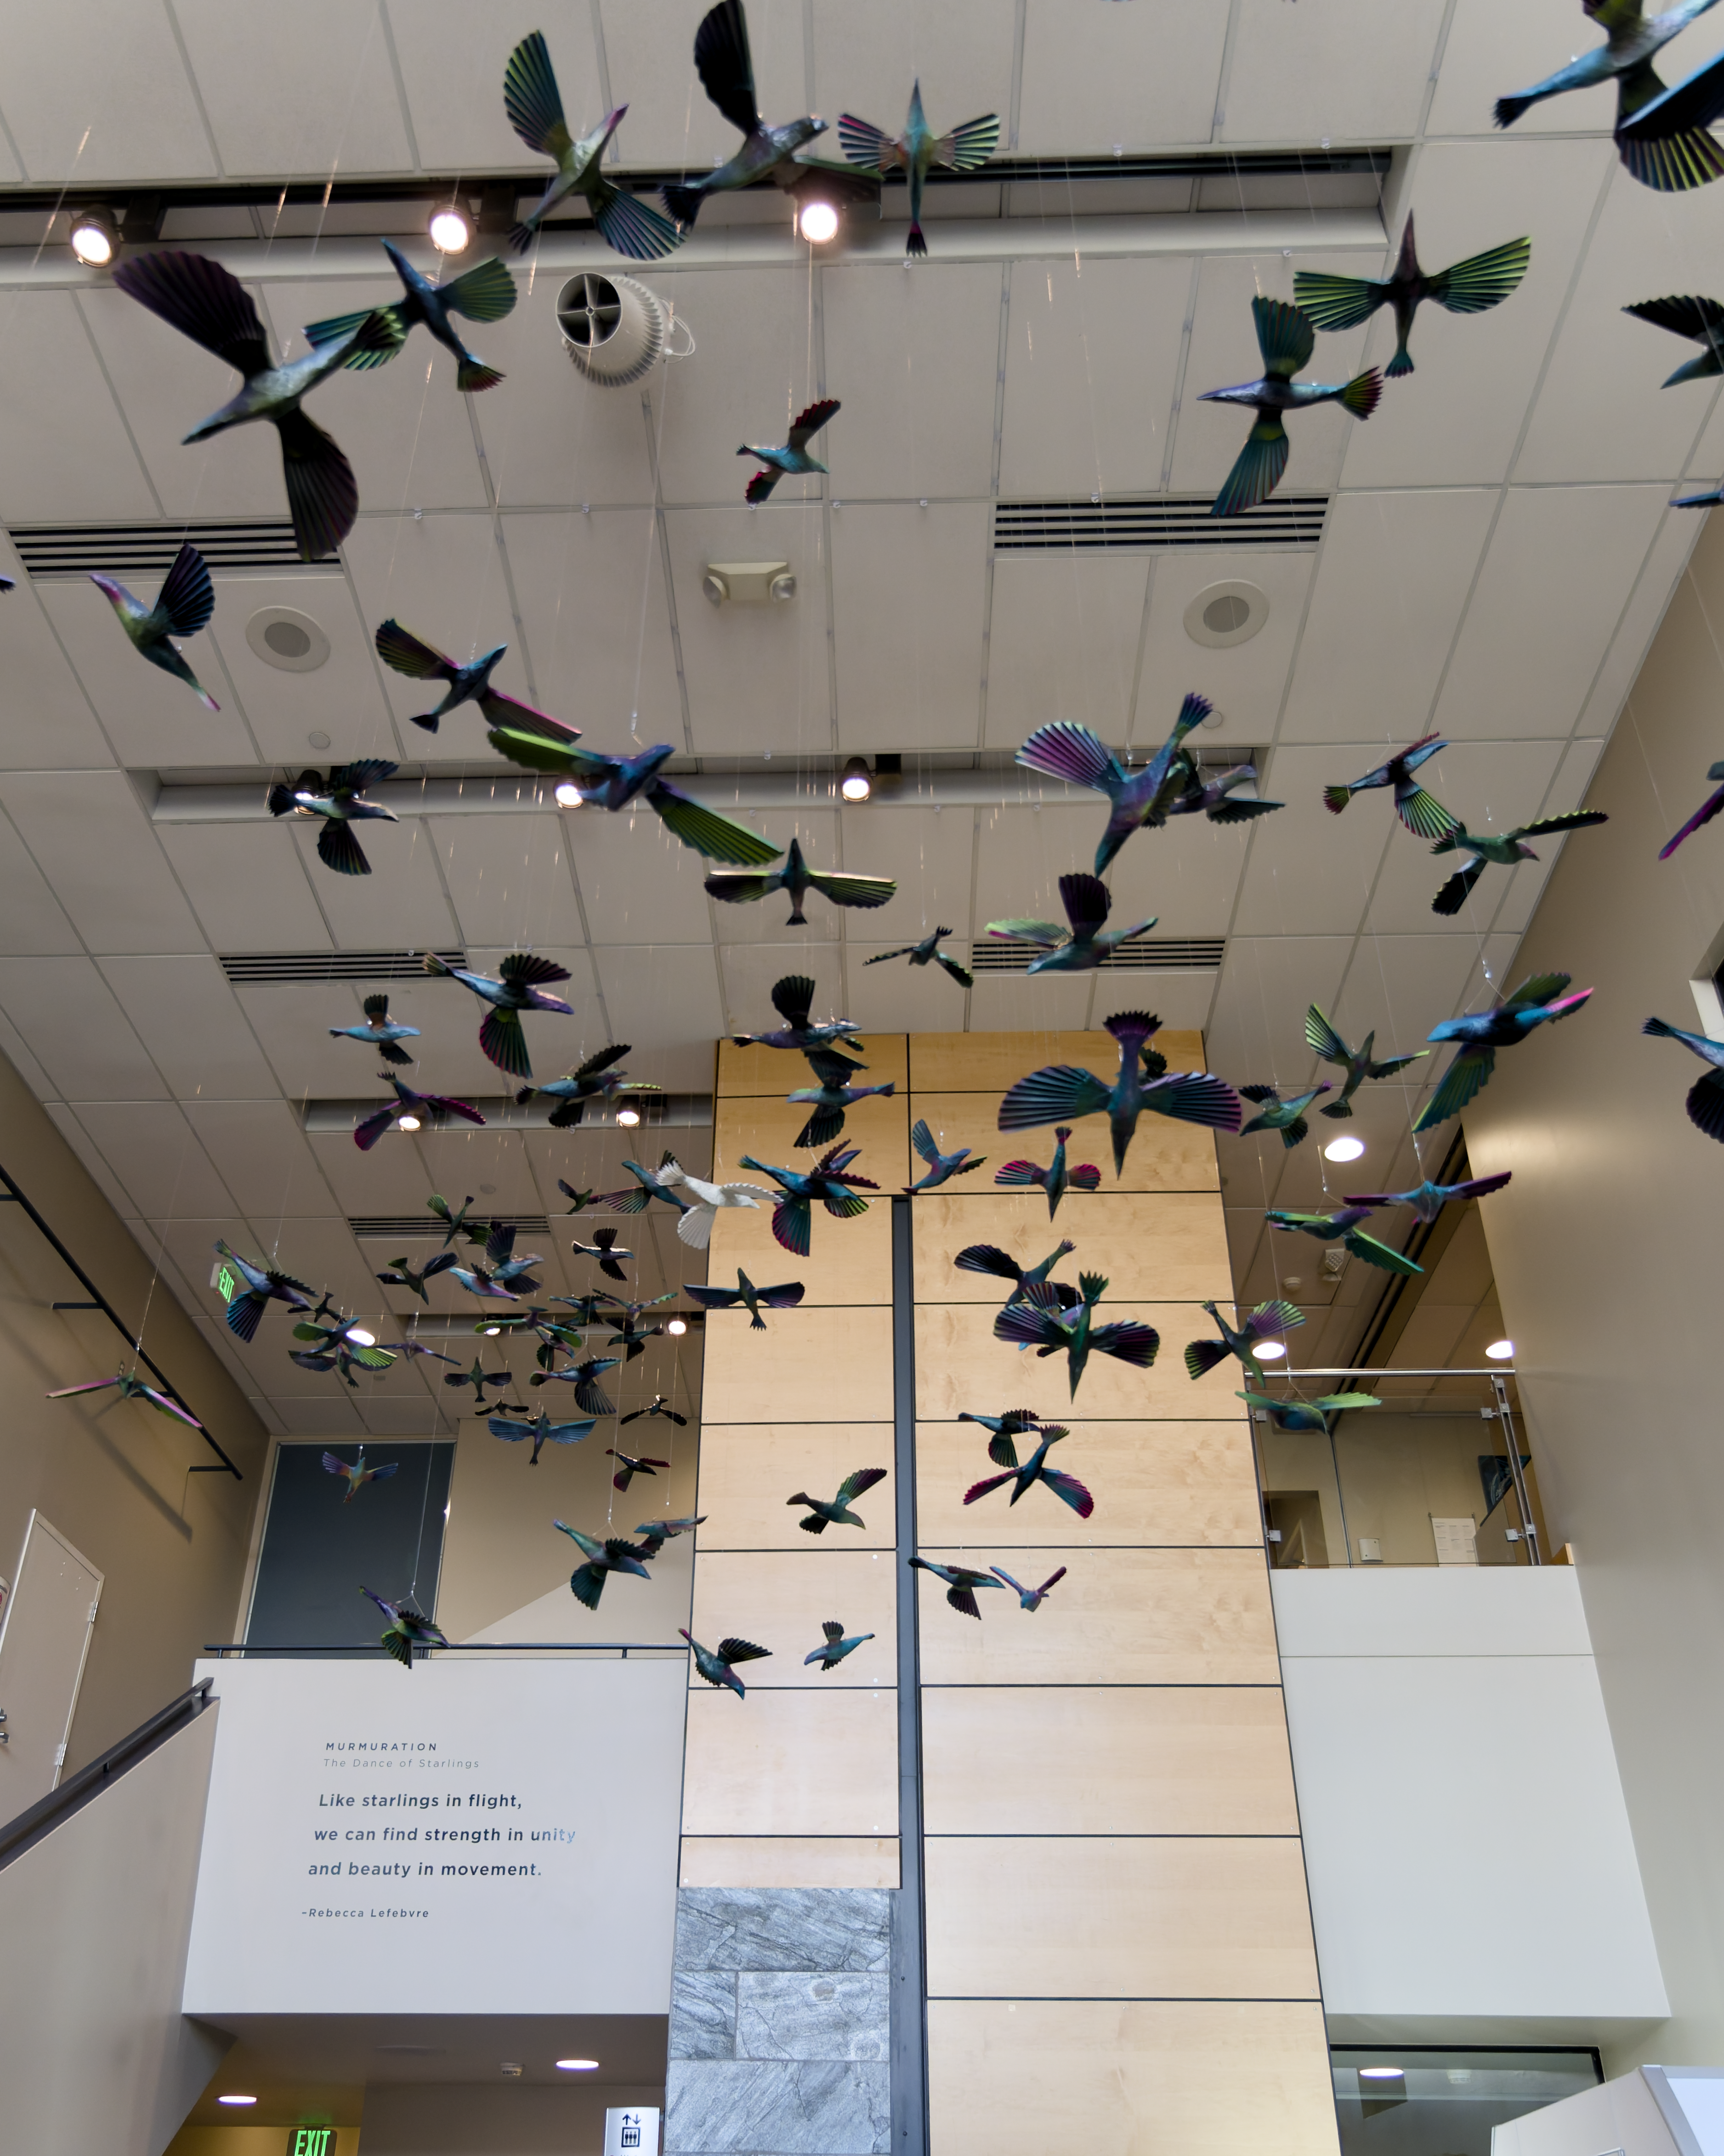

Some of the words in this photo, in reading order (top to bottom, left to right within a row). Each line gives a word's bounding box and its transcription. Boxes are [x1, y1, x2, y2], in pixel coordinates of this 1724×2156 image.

[219, 1267, 235, 1303] EXIT
[326, 1742, 437, 1751] MURMURATION
[323, 1758, 346, 1767] The
[353, 1758, 393, 1768] Dance
[399, 1758, 413, 1768] of
[419, 1758, 479, 1769] Starlings
[319, 1793, 355, 1807] Like
[362, 1793, 439, 1809] starlings
[446, 1793, 461, 1807] in
[469, 1793, 522, 1810] flight,
[314, 1830, 338, 1841] we
[345, 1830, 376, 1841] can
[383, 1827, 418, 1841] find
[424, 1827, 500, 1844] strength
[508, 1827, 523, 1841] in
[531, 1827, 576, 1844] unity
[308, 1861, 342, 1875] and
[348, 1861, 411, 1878] beauty
[418, 1862, 434, 1876] in
[441, 1863, 541, 1876] movement.
[370, 1908, 429, 1918] Lefebvre
[294, 2130, 331, 2156] EXIT
